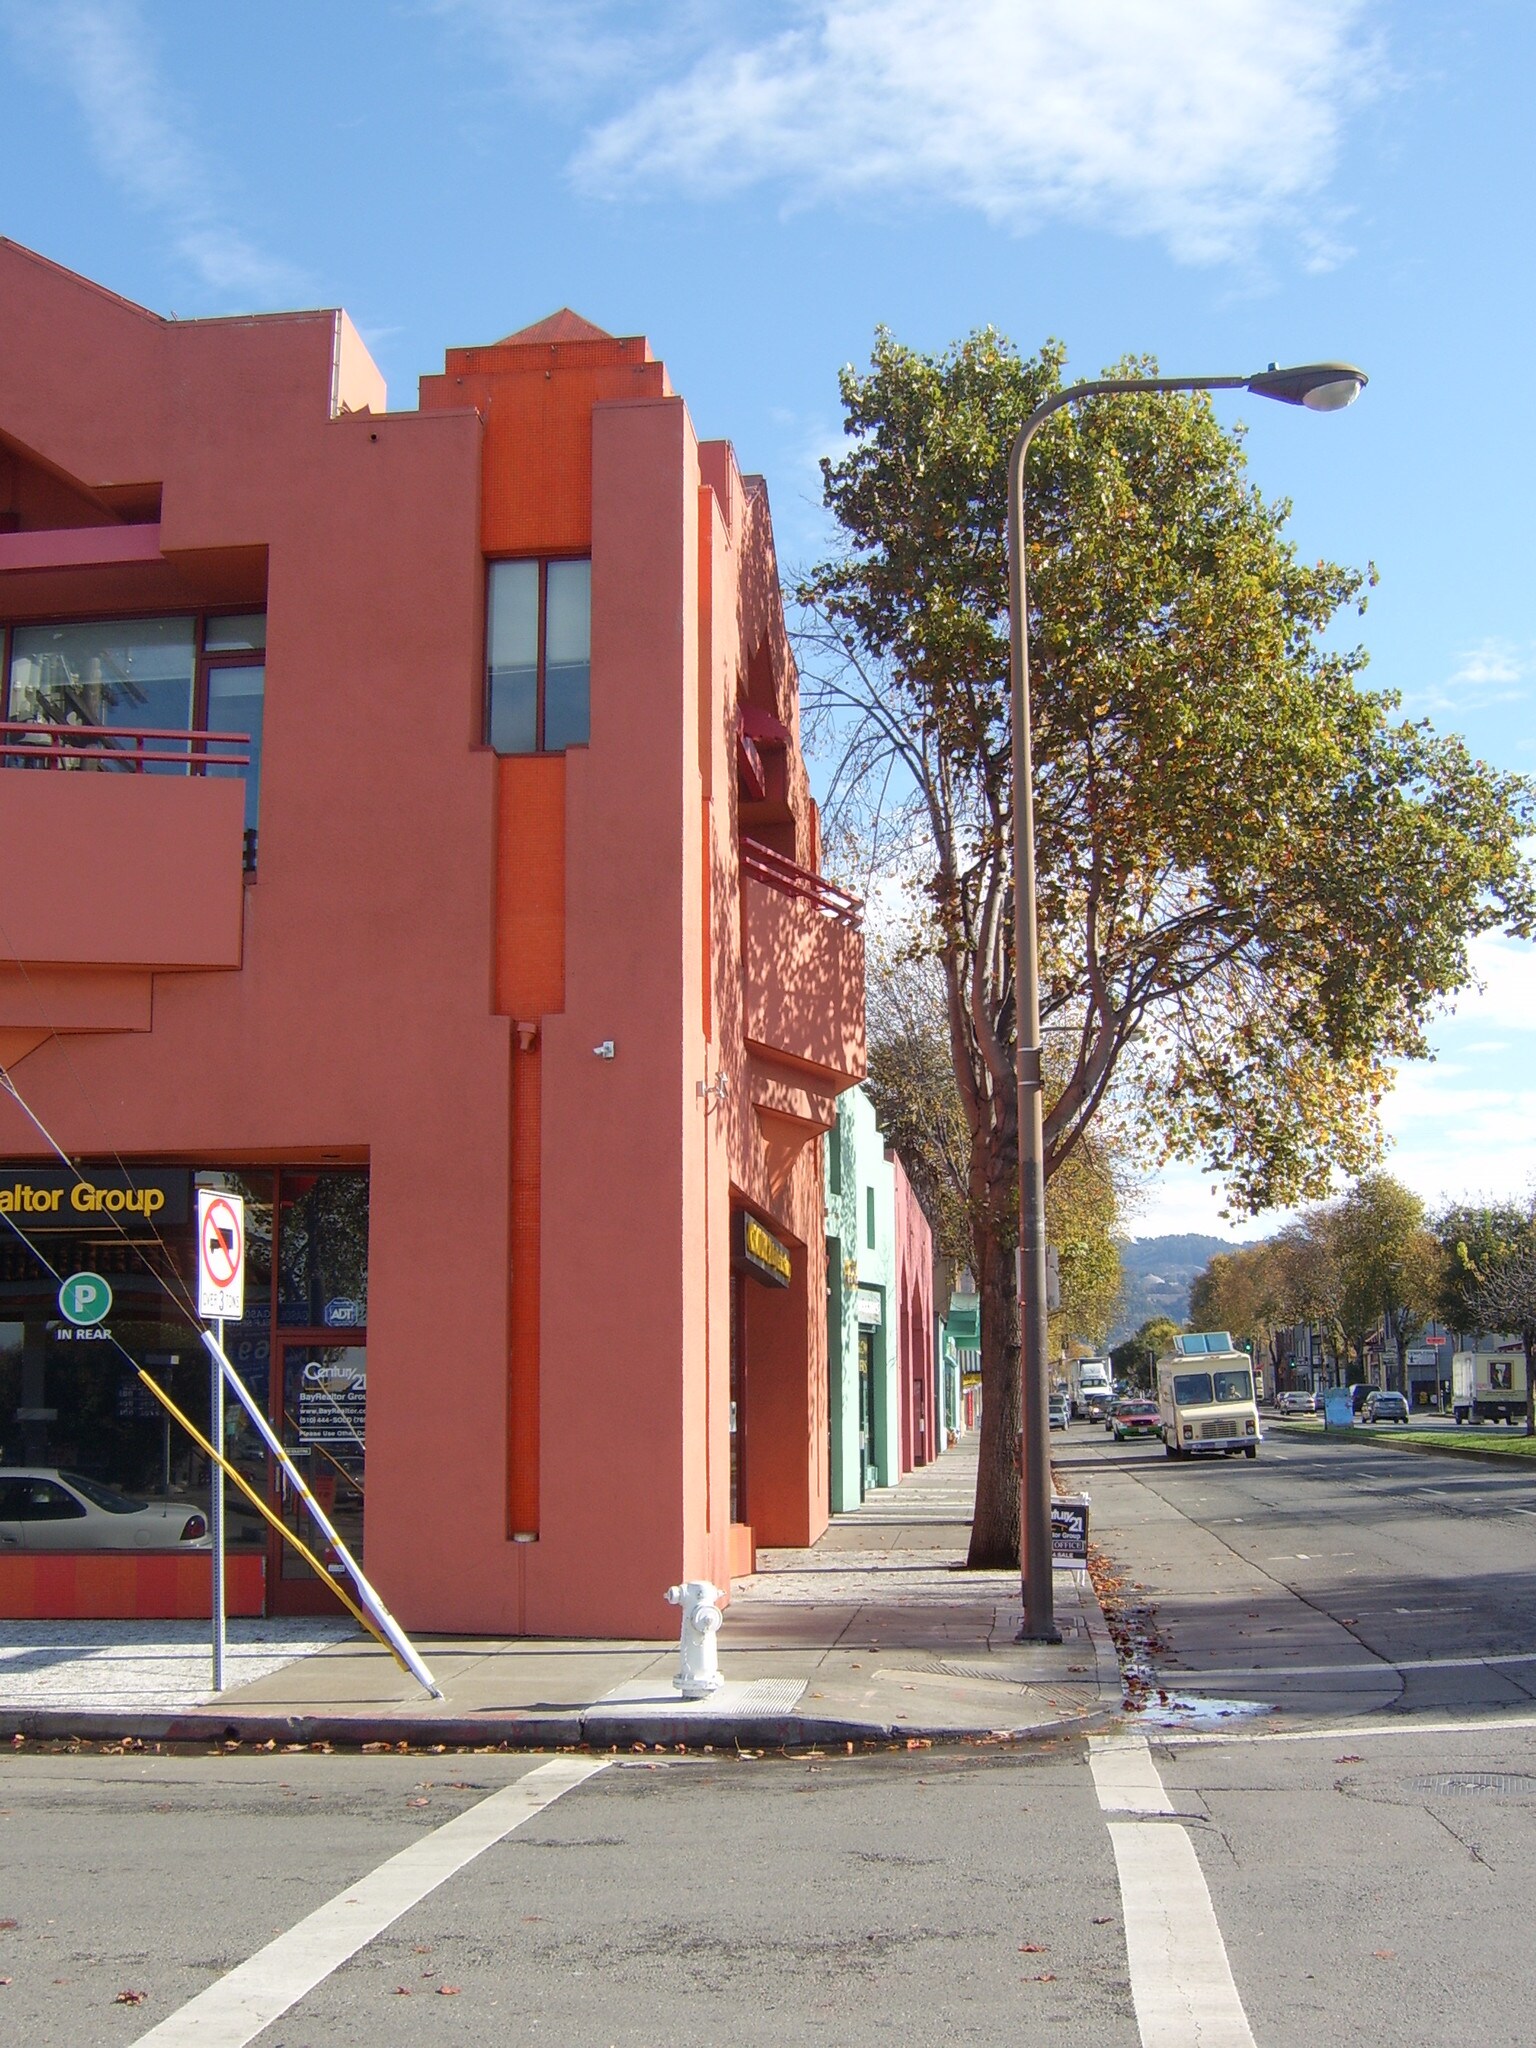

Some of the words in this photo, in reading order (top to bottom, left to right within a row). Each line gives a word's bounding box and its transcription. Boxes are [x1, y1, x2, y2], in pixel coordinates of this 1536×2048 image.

[0, 1184, 64, 1212] altor
[70, 1182, 165, 1217] Group
[75, 1285, 97, 1313] P
[218, 1290, 225, 1311] 3
[330, 1308, 353, 1320] ADT
[57, 1329, 72, 1340] IN
[76, 1329, 112, 1340] REAR
[303, 1362, 357, 1381] Century
[299, 1393, 346, 1402] BayRealtor
[1068, 1516, 1084, 1532] 21
[1062, 1532, 1081, 1540] Group
[1054, 1541, 1082, 1549] OFFICE
